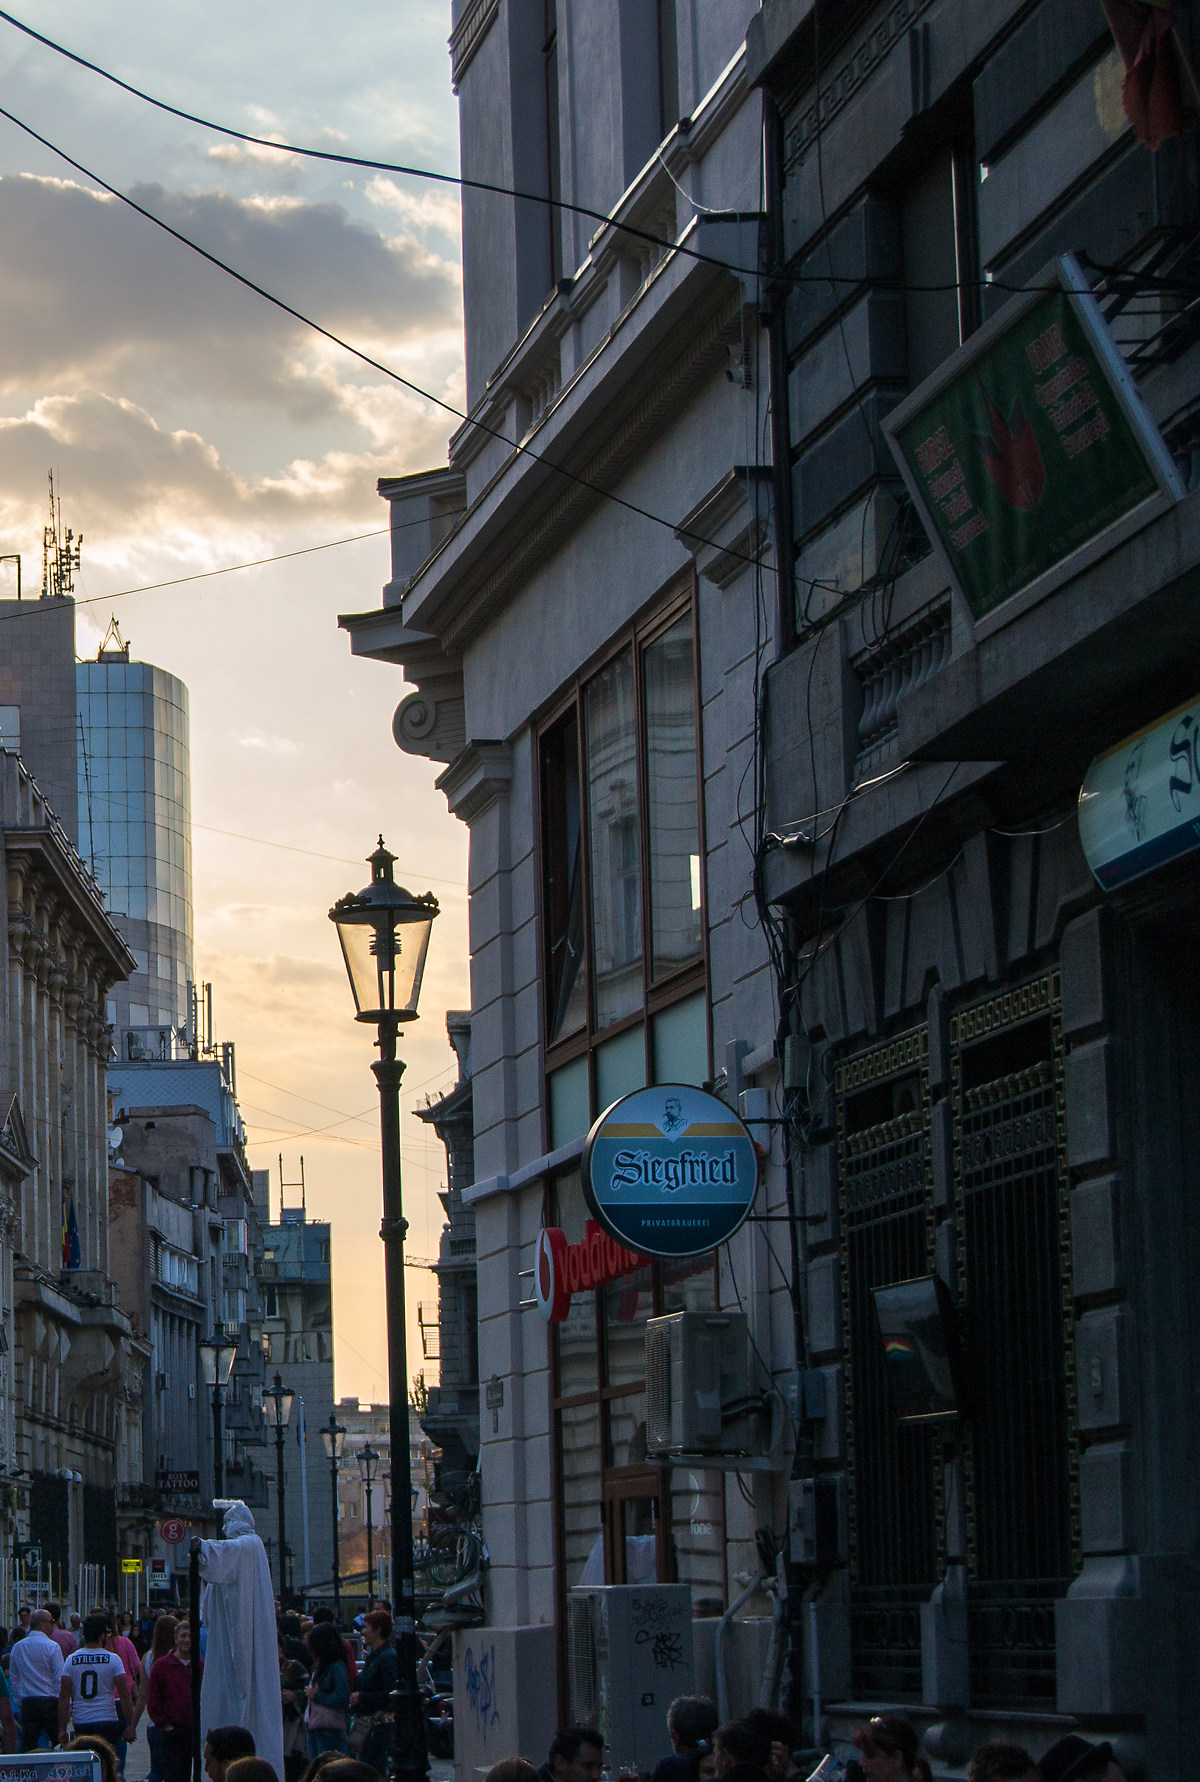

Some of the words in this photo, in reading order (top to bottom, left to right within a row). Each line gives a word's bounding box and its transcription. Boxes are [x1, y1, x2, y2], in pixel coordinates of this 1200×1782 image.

[611, 1149, 738, 1192] Siegfried
[641, 1219, 710, 1227] PRIVATBRAUEREI
[159, 1479, 198, 1488] TATTOO
[72, 1654, 110, 1665] STREETS
[81, 1670, 98, 1699] 0
[20, 1768, 38, 1780] Kg
[47, 1766, 67, 1779] 49
[70, 1764, 92, 1777] lei
